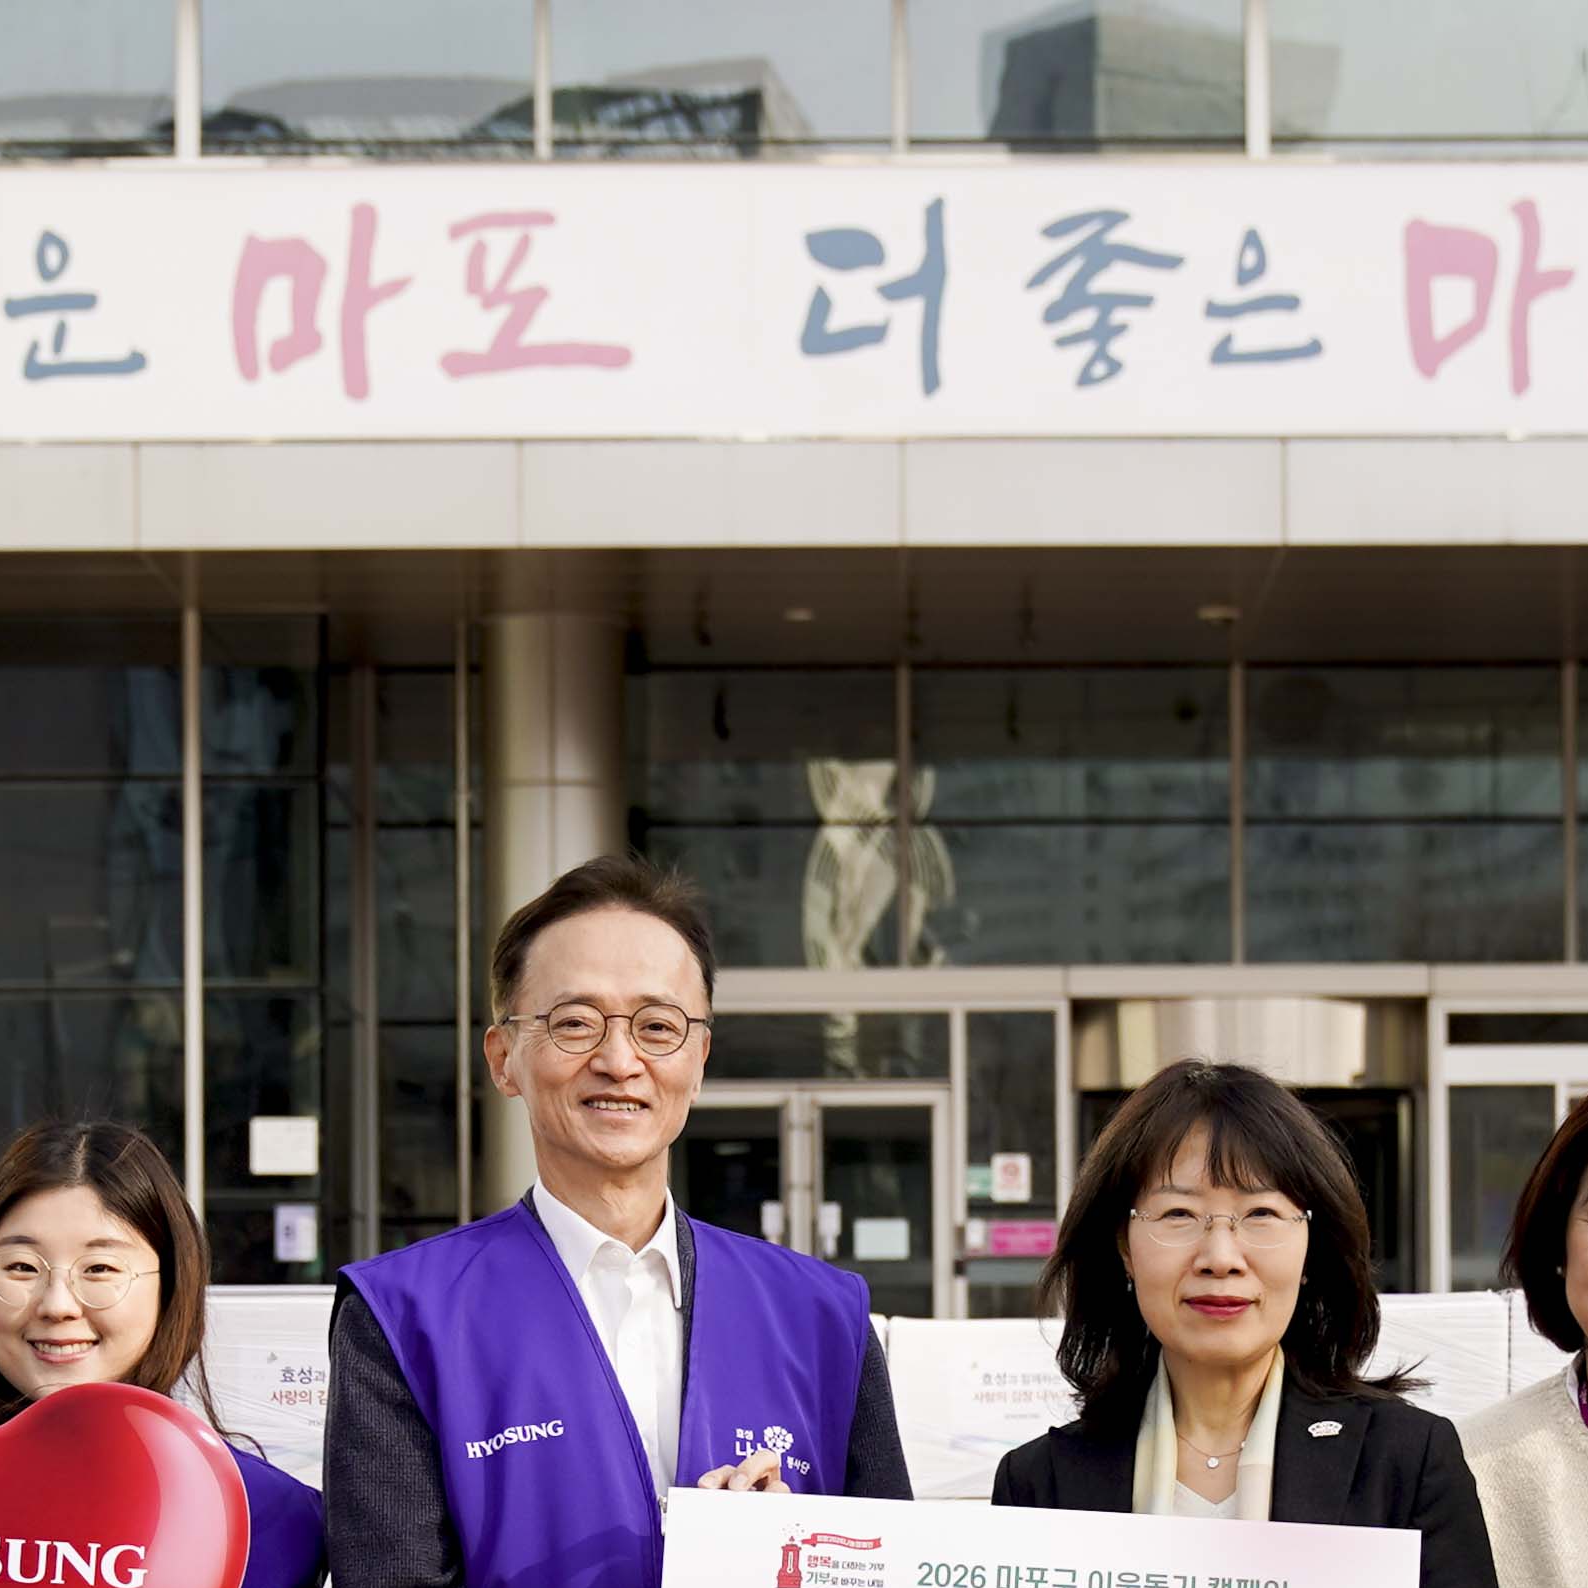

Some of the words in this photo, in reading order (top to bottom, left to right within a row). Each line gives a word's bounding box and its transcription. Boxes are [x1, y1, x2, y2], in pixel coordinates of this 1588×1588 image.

[230, 203, 632, 399] 마포
[800, 197, 947, 395] 더
[1023, 207, 1324, 391] 좋은
[279, 1366, 327, 1385] 효성과
[269, 1390, 313, 1406] 사랑의
[465, 1420, 564, 1459] HYOSUNG
